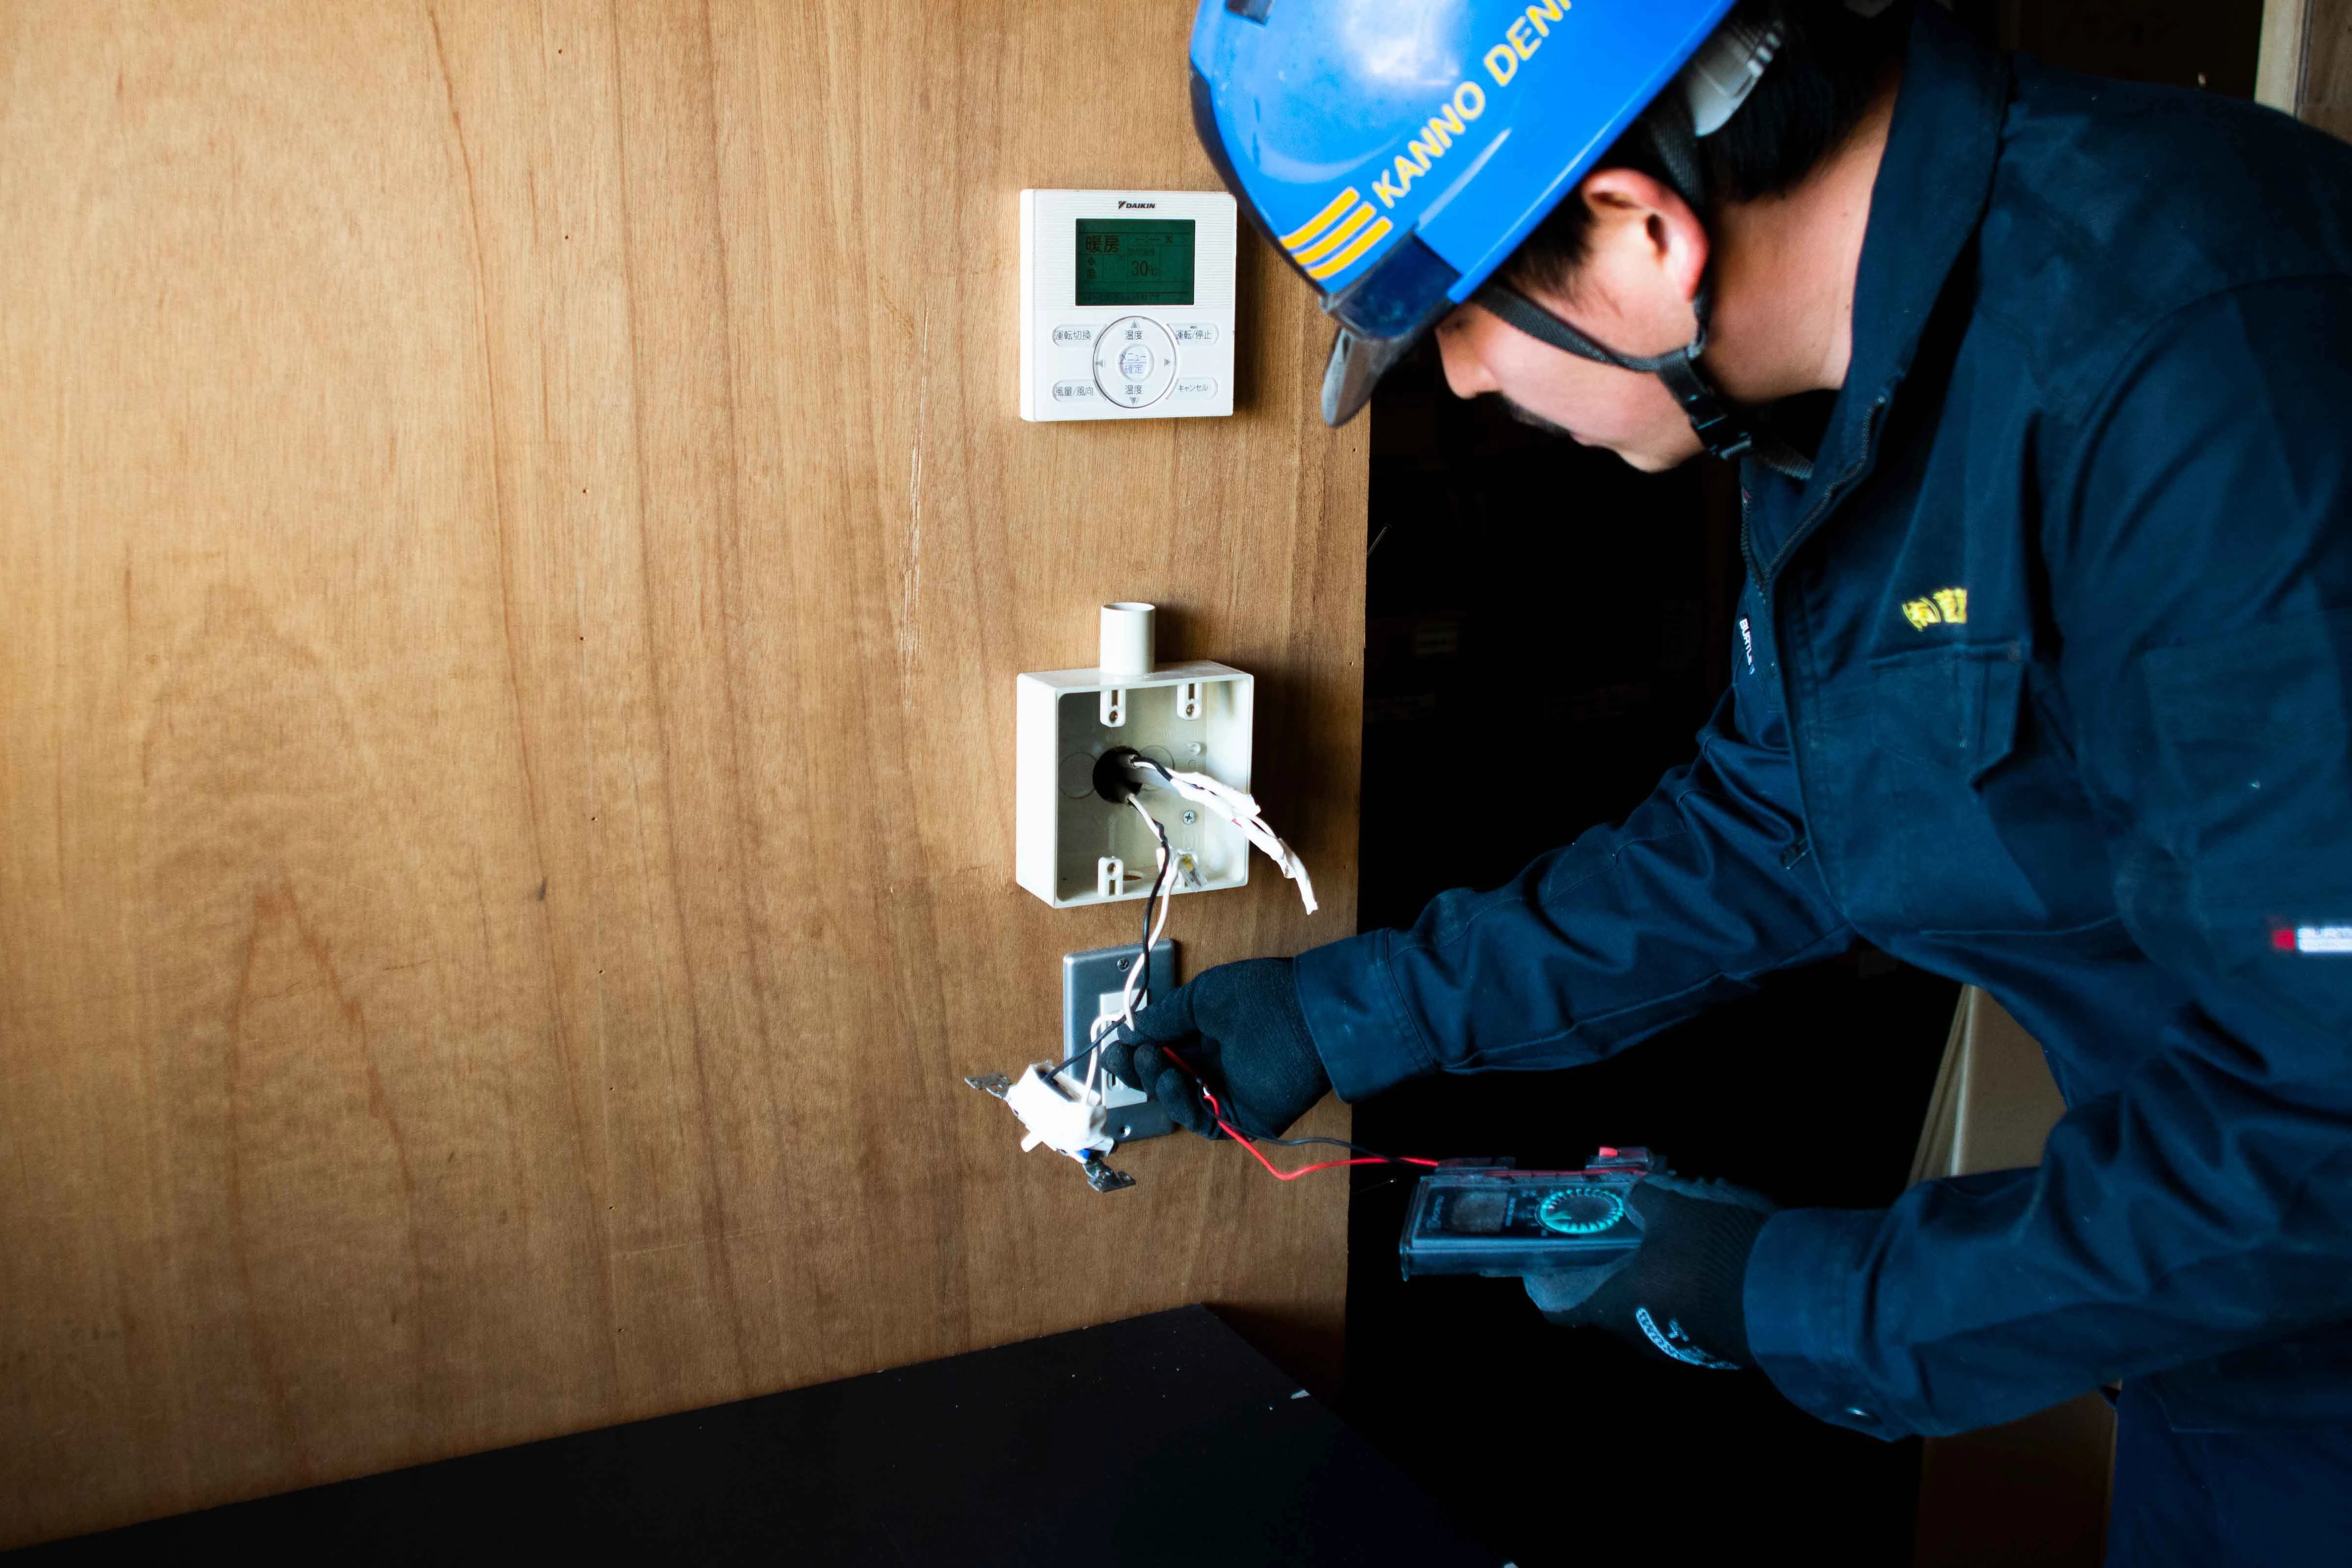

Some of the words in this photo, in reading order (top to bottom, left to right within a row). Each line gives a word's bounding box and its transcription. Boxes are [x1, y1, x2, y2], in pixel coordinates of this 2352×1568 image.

[1372, 81, 1485, 208] KANNO
[1484, 0, 1571, 87] DEN
[1086, 235, 1119, 253] 暖房
[1054, 330, 1091, 340] 運転切換
[1125, 330, 1143, 340] 温度
[1176, 330, 1211, 340] 運転/停止
[1121, 352, 1146, 361] メニュー
[1125, 365, 1143, 374] 確定
[1055, 386, 1094, 396] 風量/風向
[1125, 385, 1143, 395] 温度
